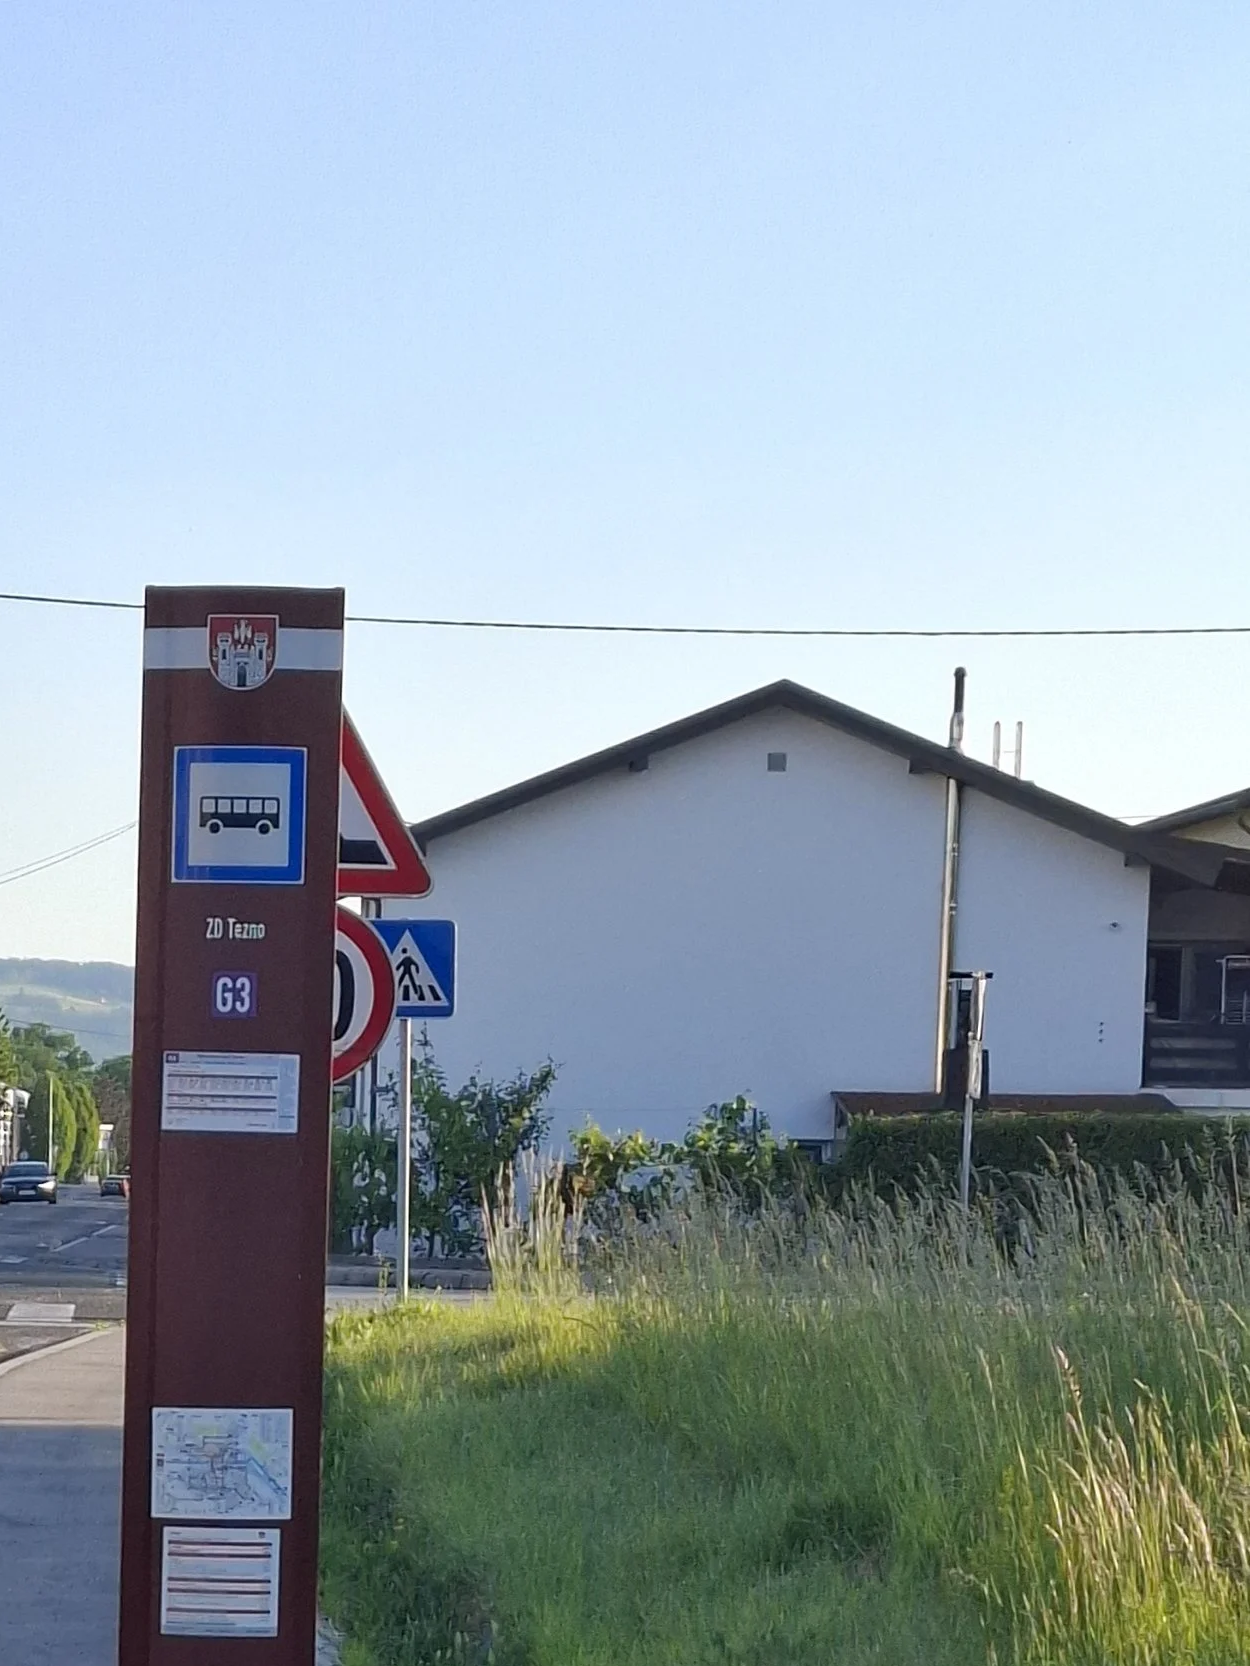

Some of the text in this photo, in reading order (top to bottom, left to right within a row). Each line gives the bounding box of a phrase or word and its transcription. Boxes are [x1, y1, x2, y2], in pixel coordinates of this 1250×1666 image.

[206, 918, 266, 939] ZD Tezno
[216, 976, 251, 1013] G3
